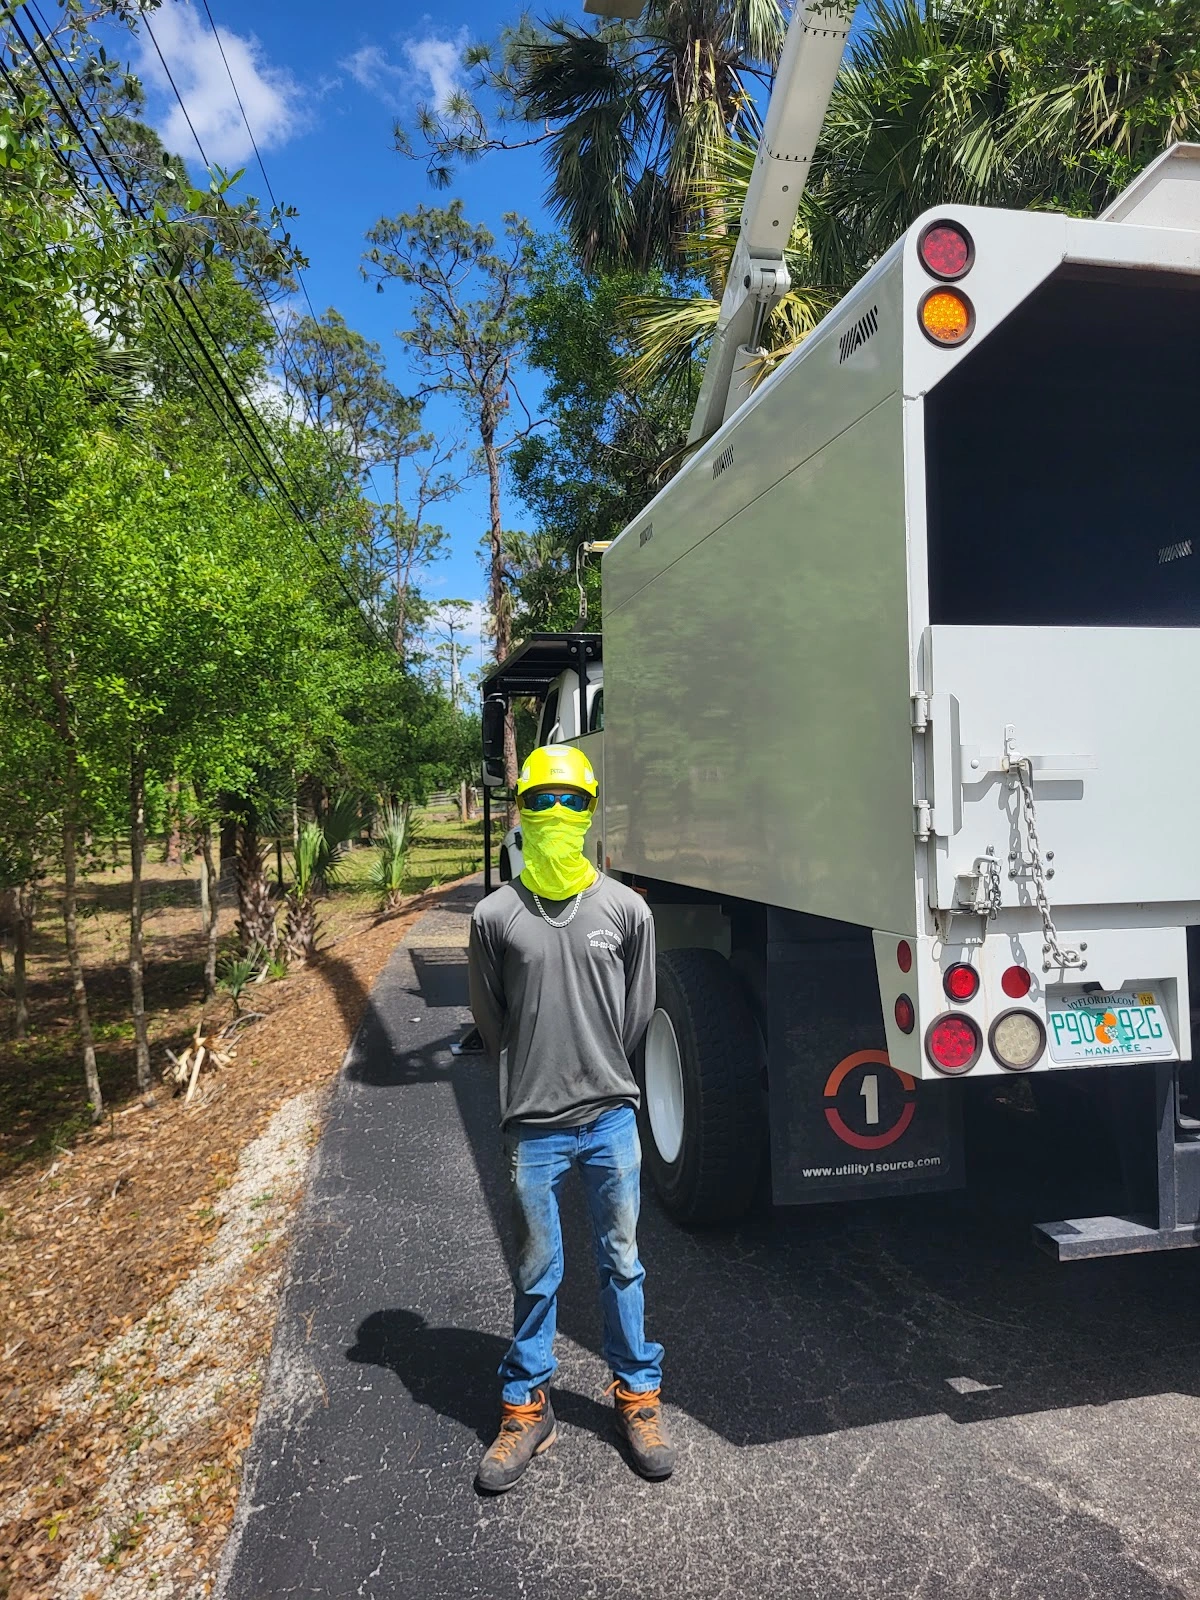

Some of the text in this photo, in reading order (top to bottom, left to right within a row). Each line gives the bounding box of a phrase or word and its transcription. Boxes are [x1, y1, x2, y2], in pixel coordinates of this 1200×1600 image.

[1067, 995, 1134, 1010] MYFLORIDA.COM
[1051, 1007, 1162, 1046] P90 92G
[1085, 1043, 1141, 1056] MANATEE
[860, 1074, 879, 1124] 1
[802, 1157, 941, 1177] www.utility1source.com
